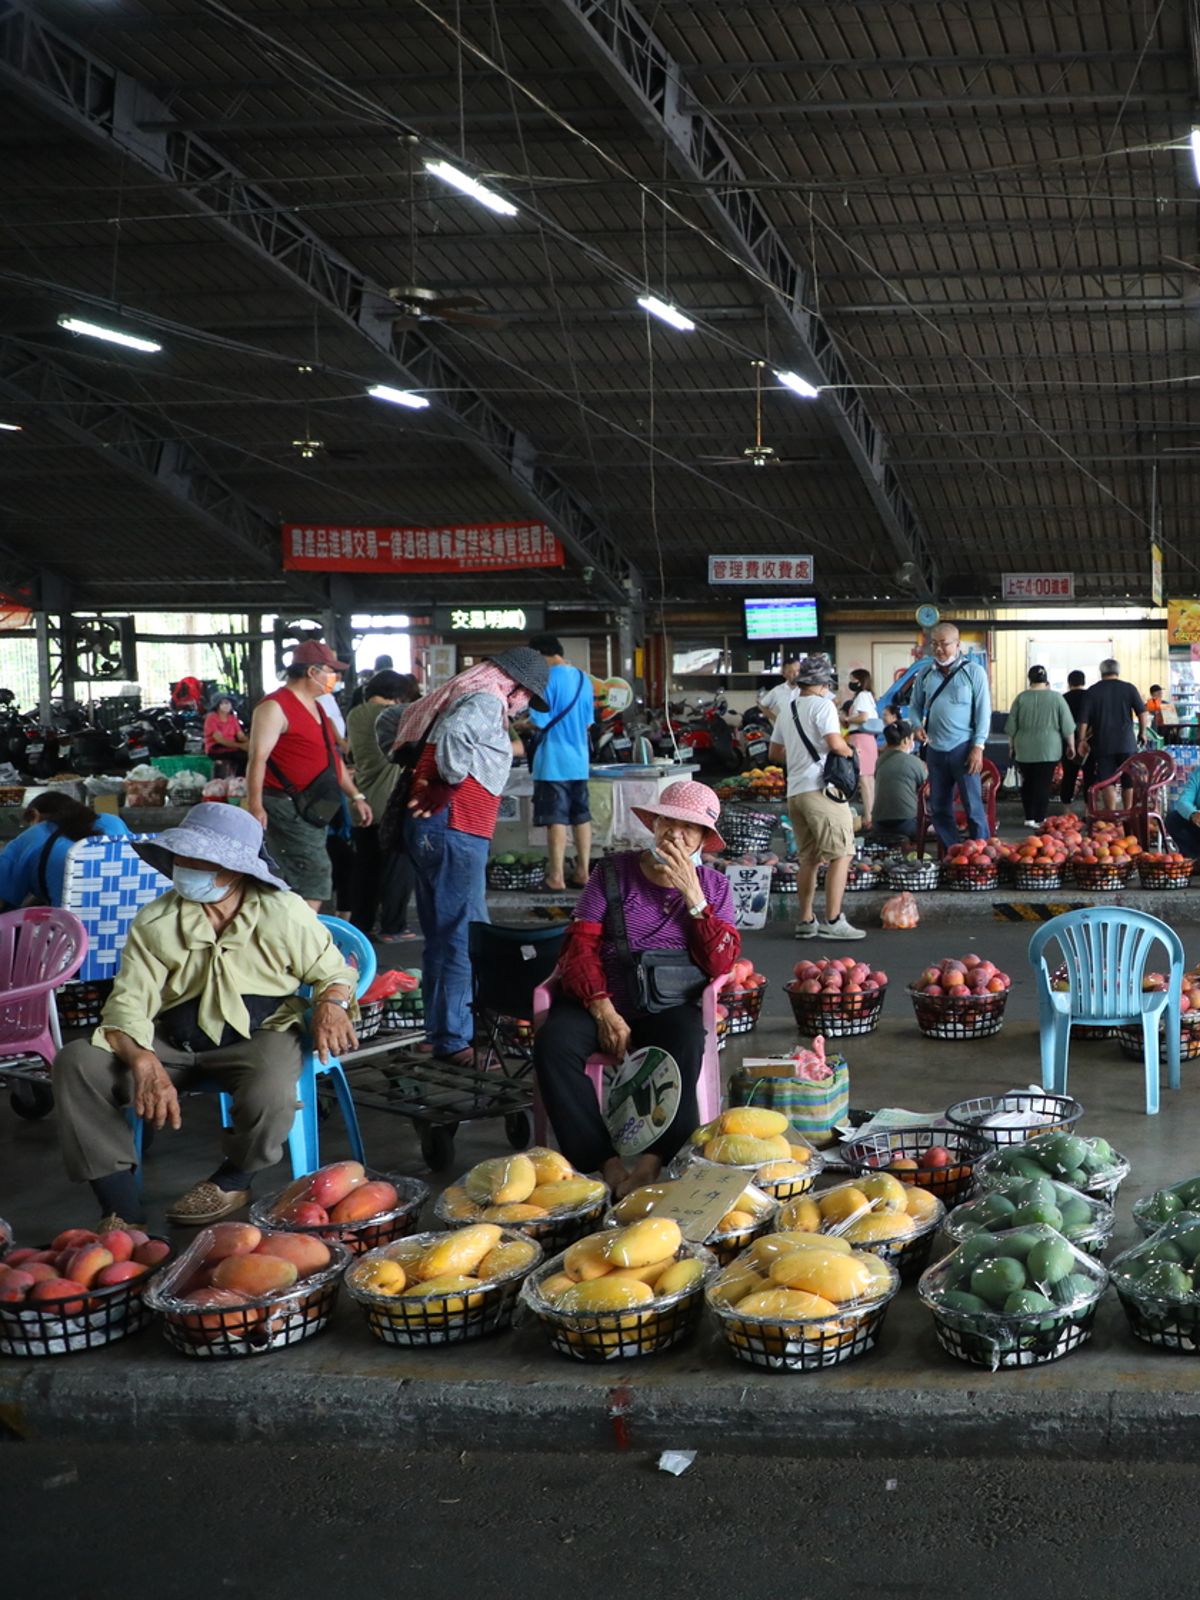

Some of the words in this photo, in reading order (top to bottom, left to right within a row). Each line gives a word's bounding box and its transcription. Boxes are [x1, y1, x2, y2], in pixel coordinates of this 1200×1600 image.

[713, 560, 810, 579] 管理費收費處
